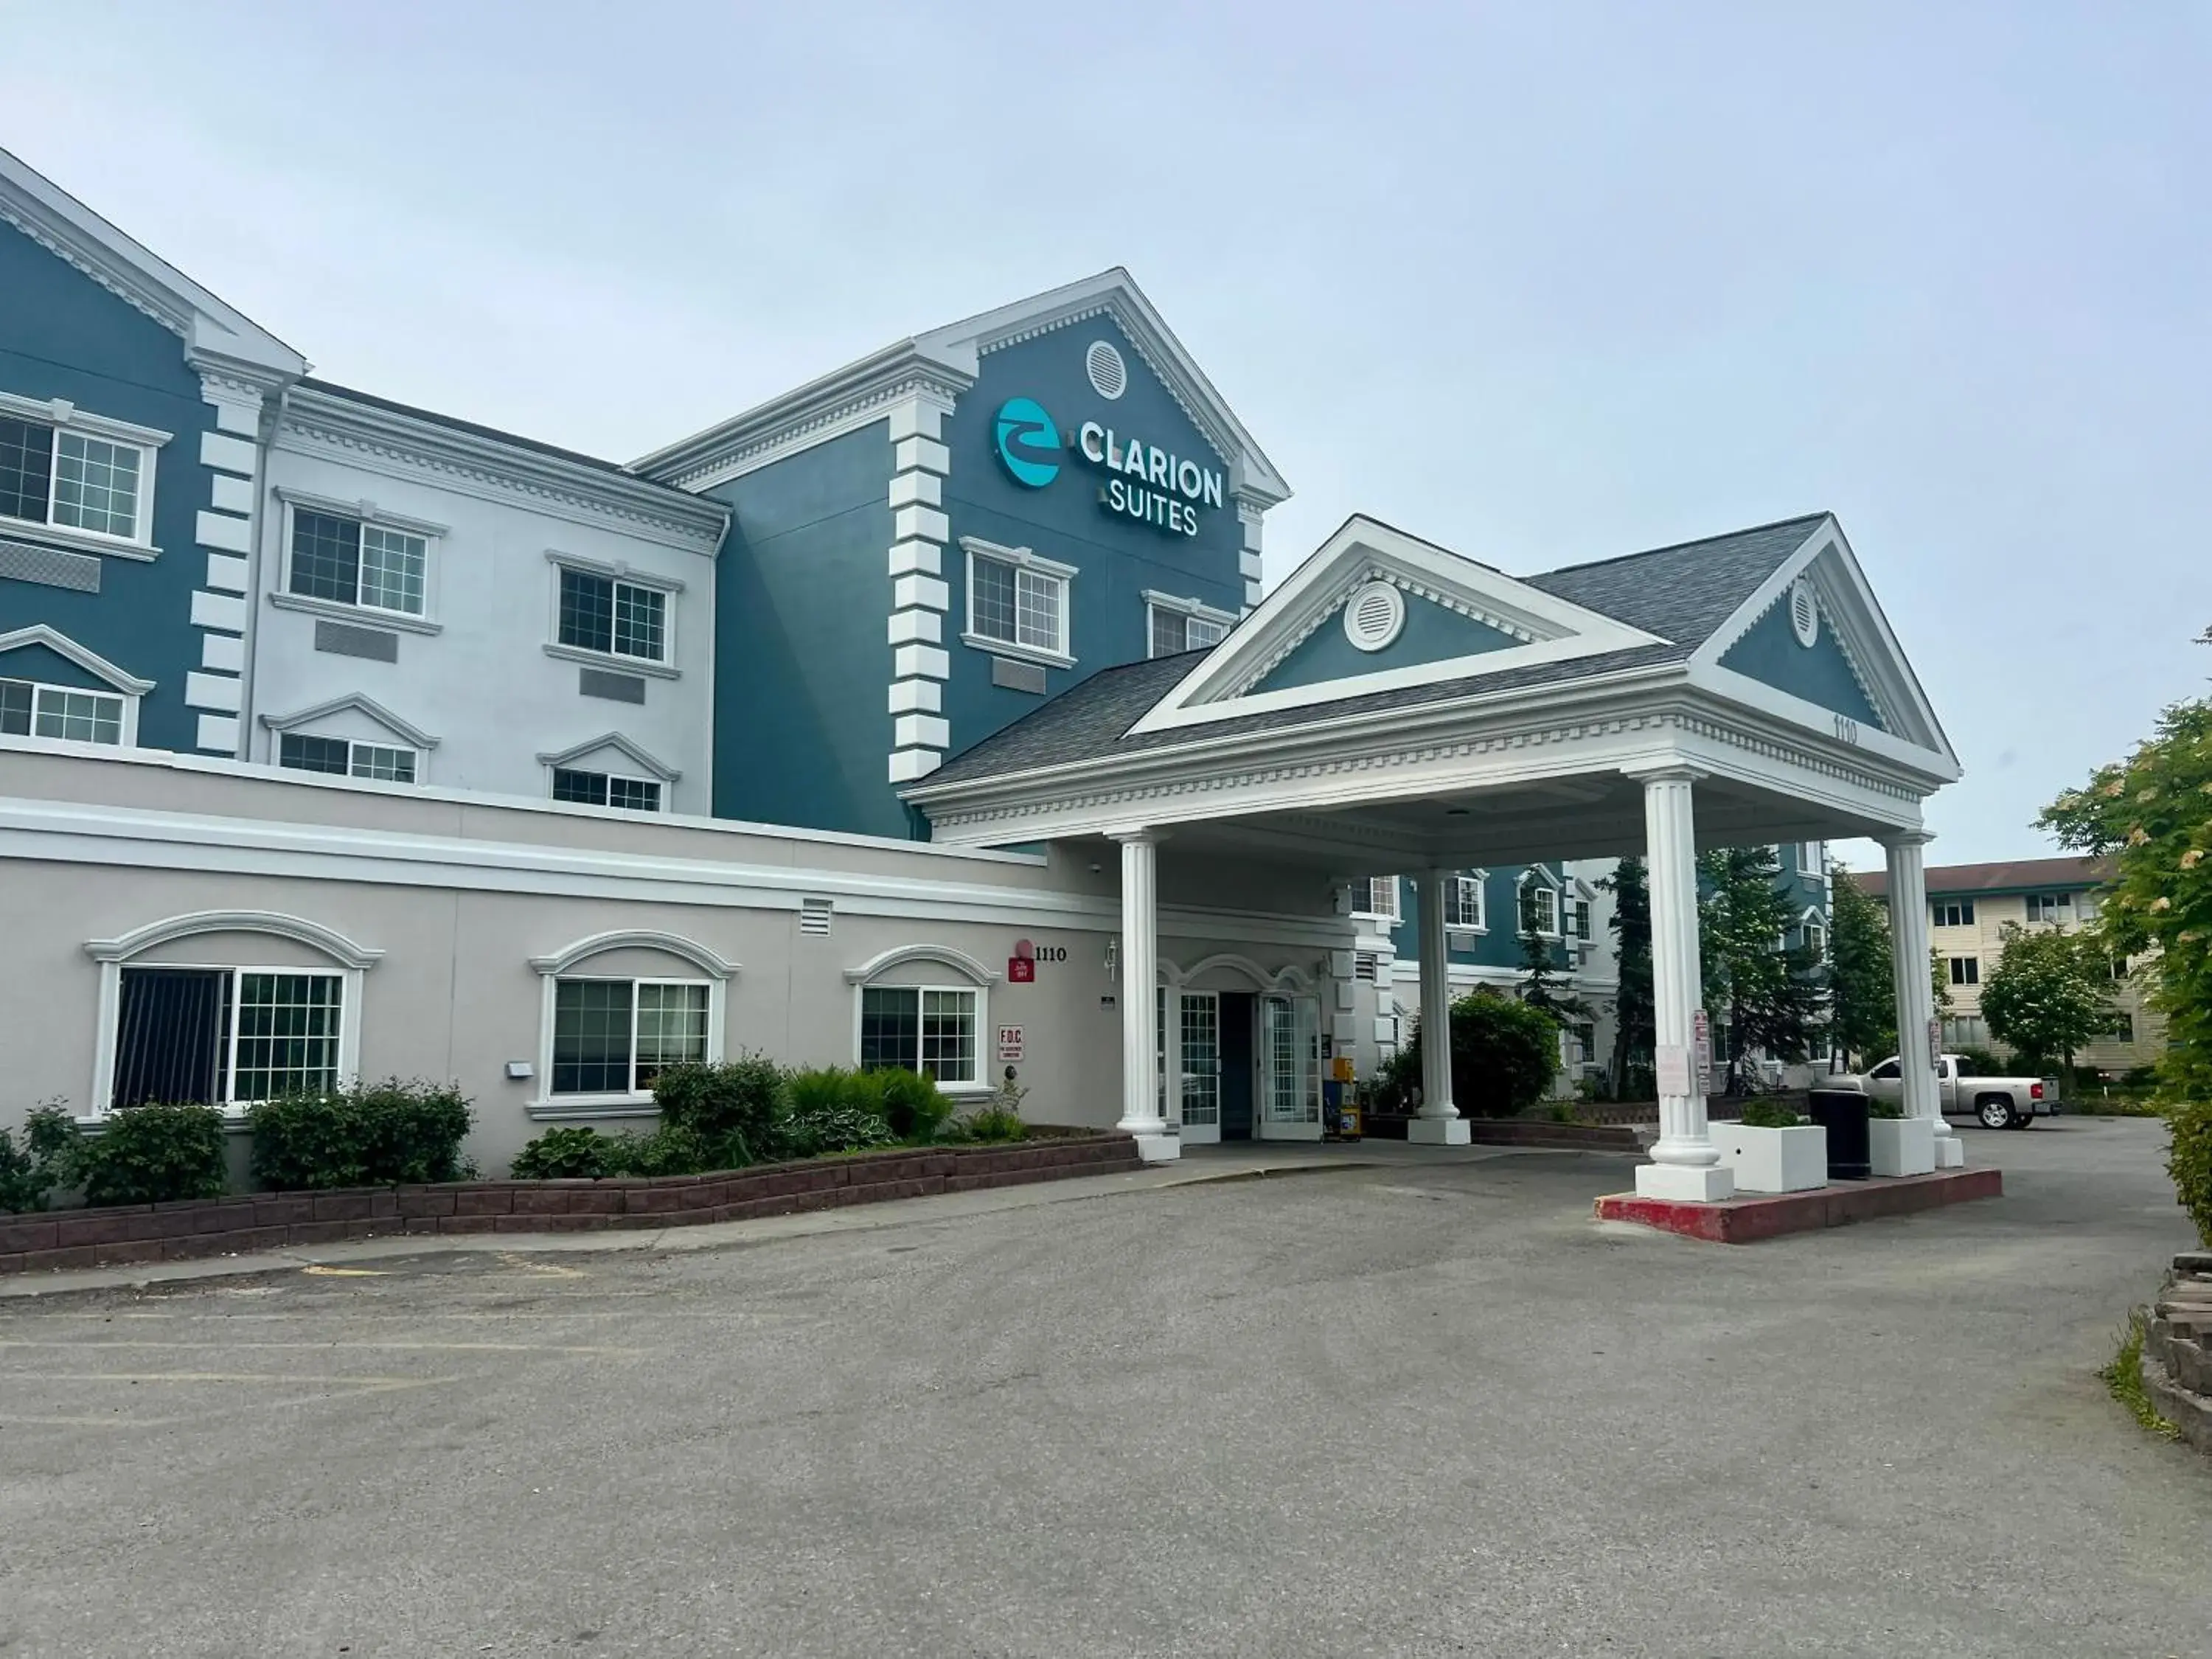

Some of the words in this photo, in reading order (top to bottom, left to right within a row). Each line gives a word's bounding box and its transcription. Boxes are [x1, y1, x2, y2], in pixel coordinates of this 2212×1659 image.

[1080, 421, 1222, 508] CLARION
[1110, 479, 1197, 536] SUITES
[1036, 947, 1067, 961] 1110
